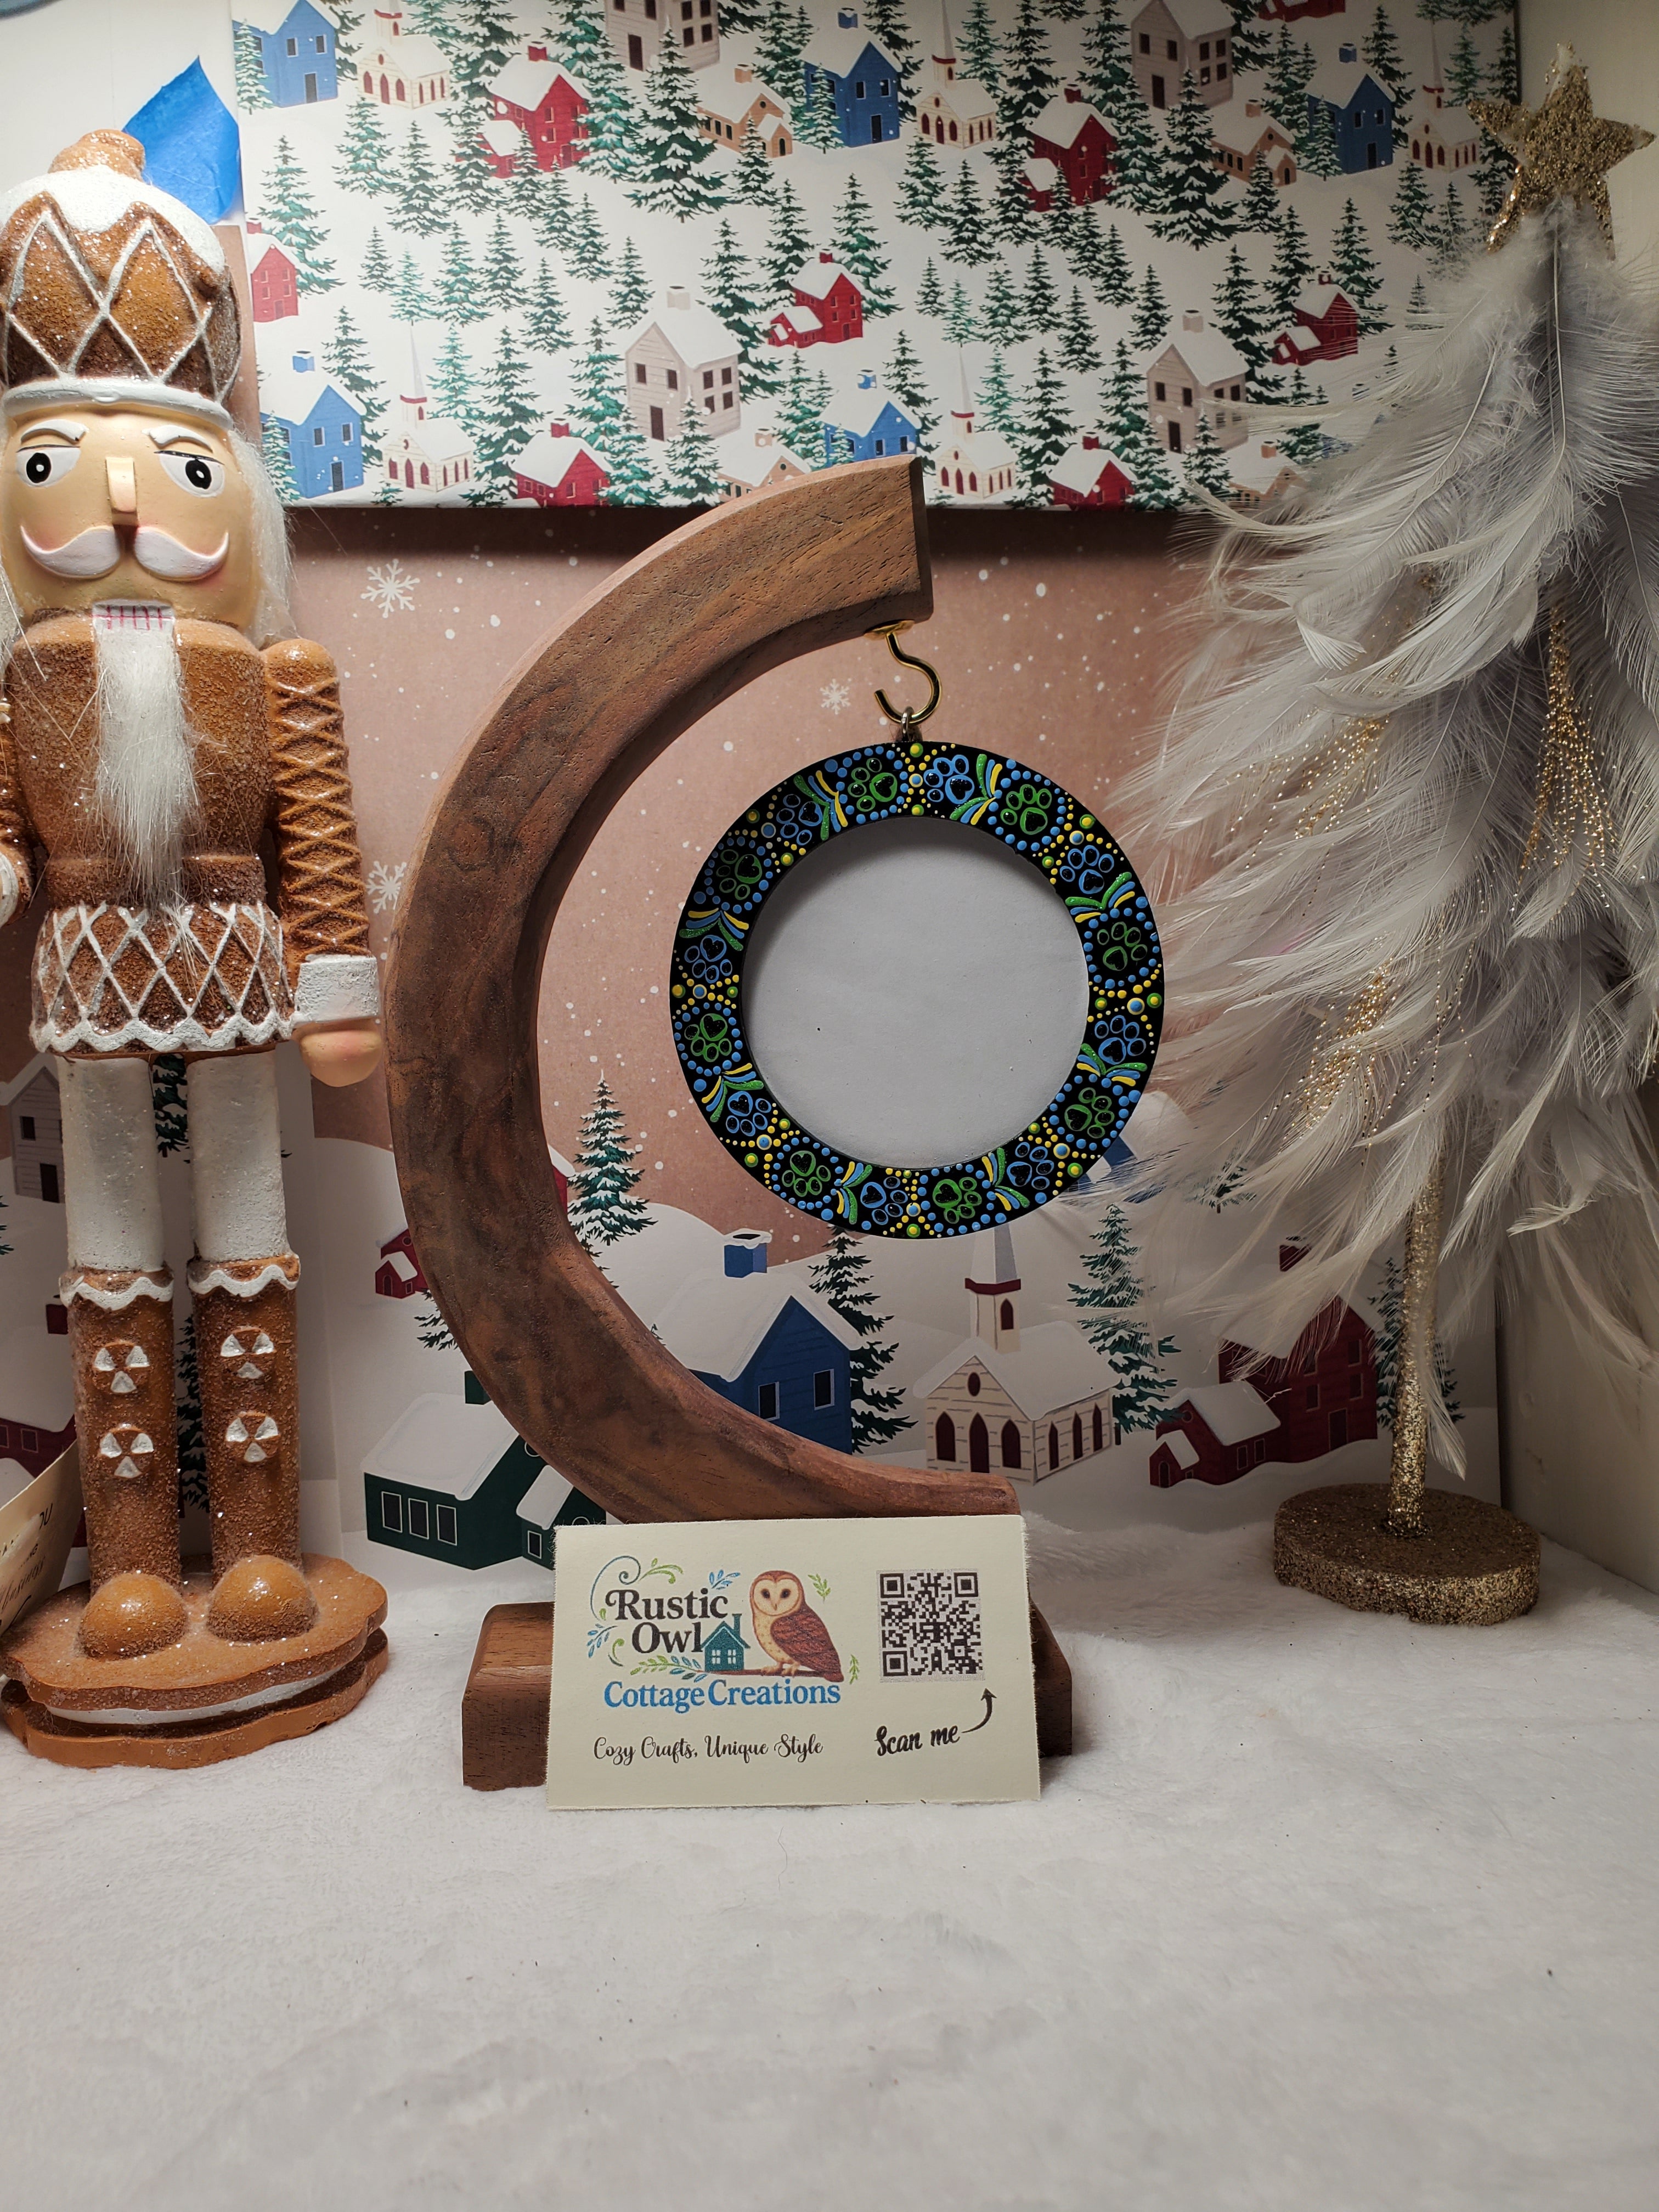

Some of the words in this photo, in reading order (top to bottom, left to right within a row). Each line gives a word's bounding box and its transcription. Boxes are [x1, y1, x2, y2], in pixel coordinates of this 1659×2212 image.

[605, 1588, 729, 1621] Rustic
[631, 1621, 703, 1654] Owl
[604, 1680, 706, 1714] Cottage
[707, 1678, 842, 1706] Creations
[593, 1736, 636, 1766] Cozy
[641, 1735, 698, 1764] Crafts,
[704, 1735, 769, 1764] Unique
[774, 1733, 823, 1763] Style
[874, 1725, 923, 1757] Scan
[930, 1725, 961, 1747] me
